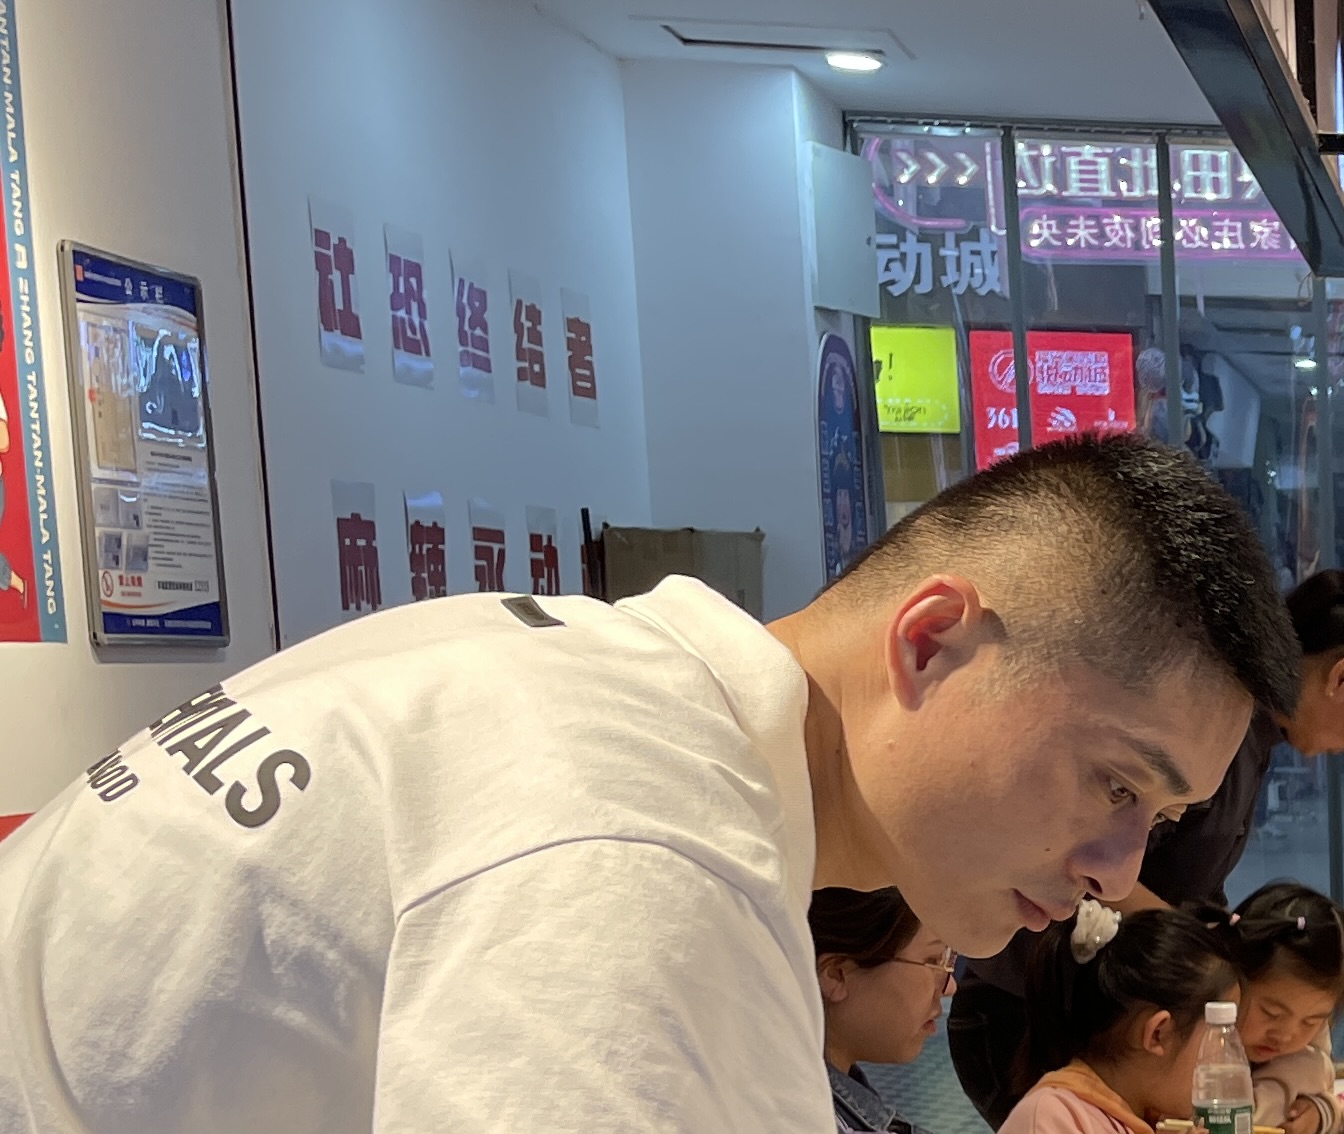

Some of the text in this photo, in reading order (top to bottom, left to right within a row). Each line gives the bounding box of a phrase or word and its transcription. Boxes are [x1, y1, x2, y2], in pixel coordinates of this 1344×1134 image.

[313, 228, 597, 400] 社恐终结者
[42, 551, 57, 614] TANG
